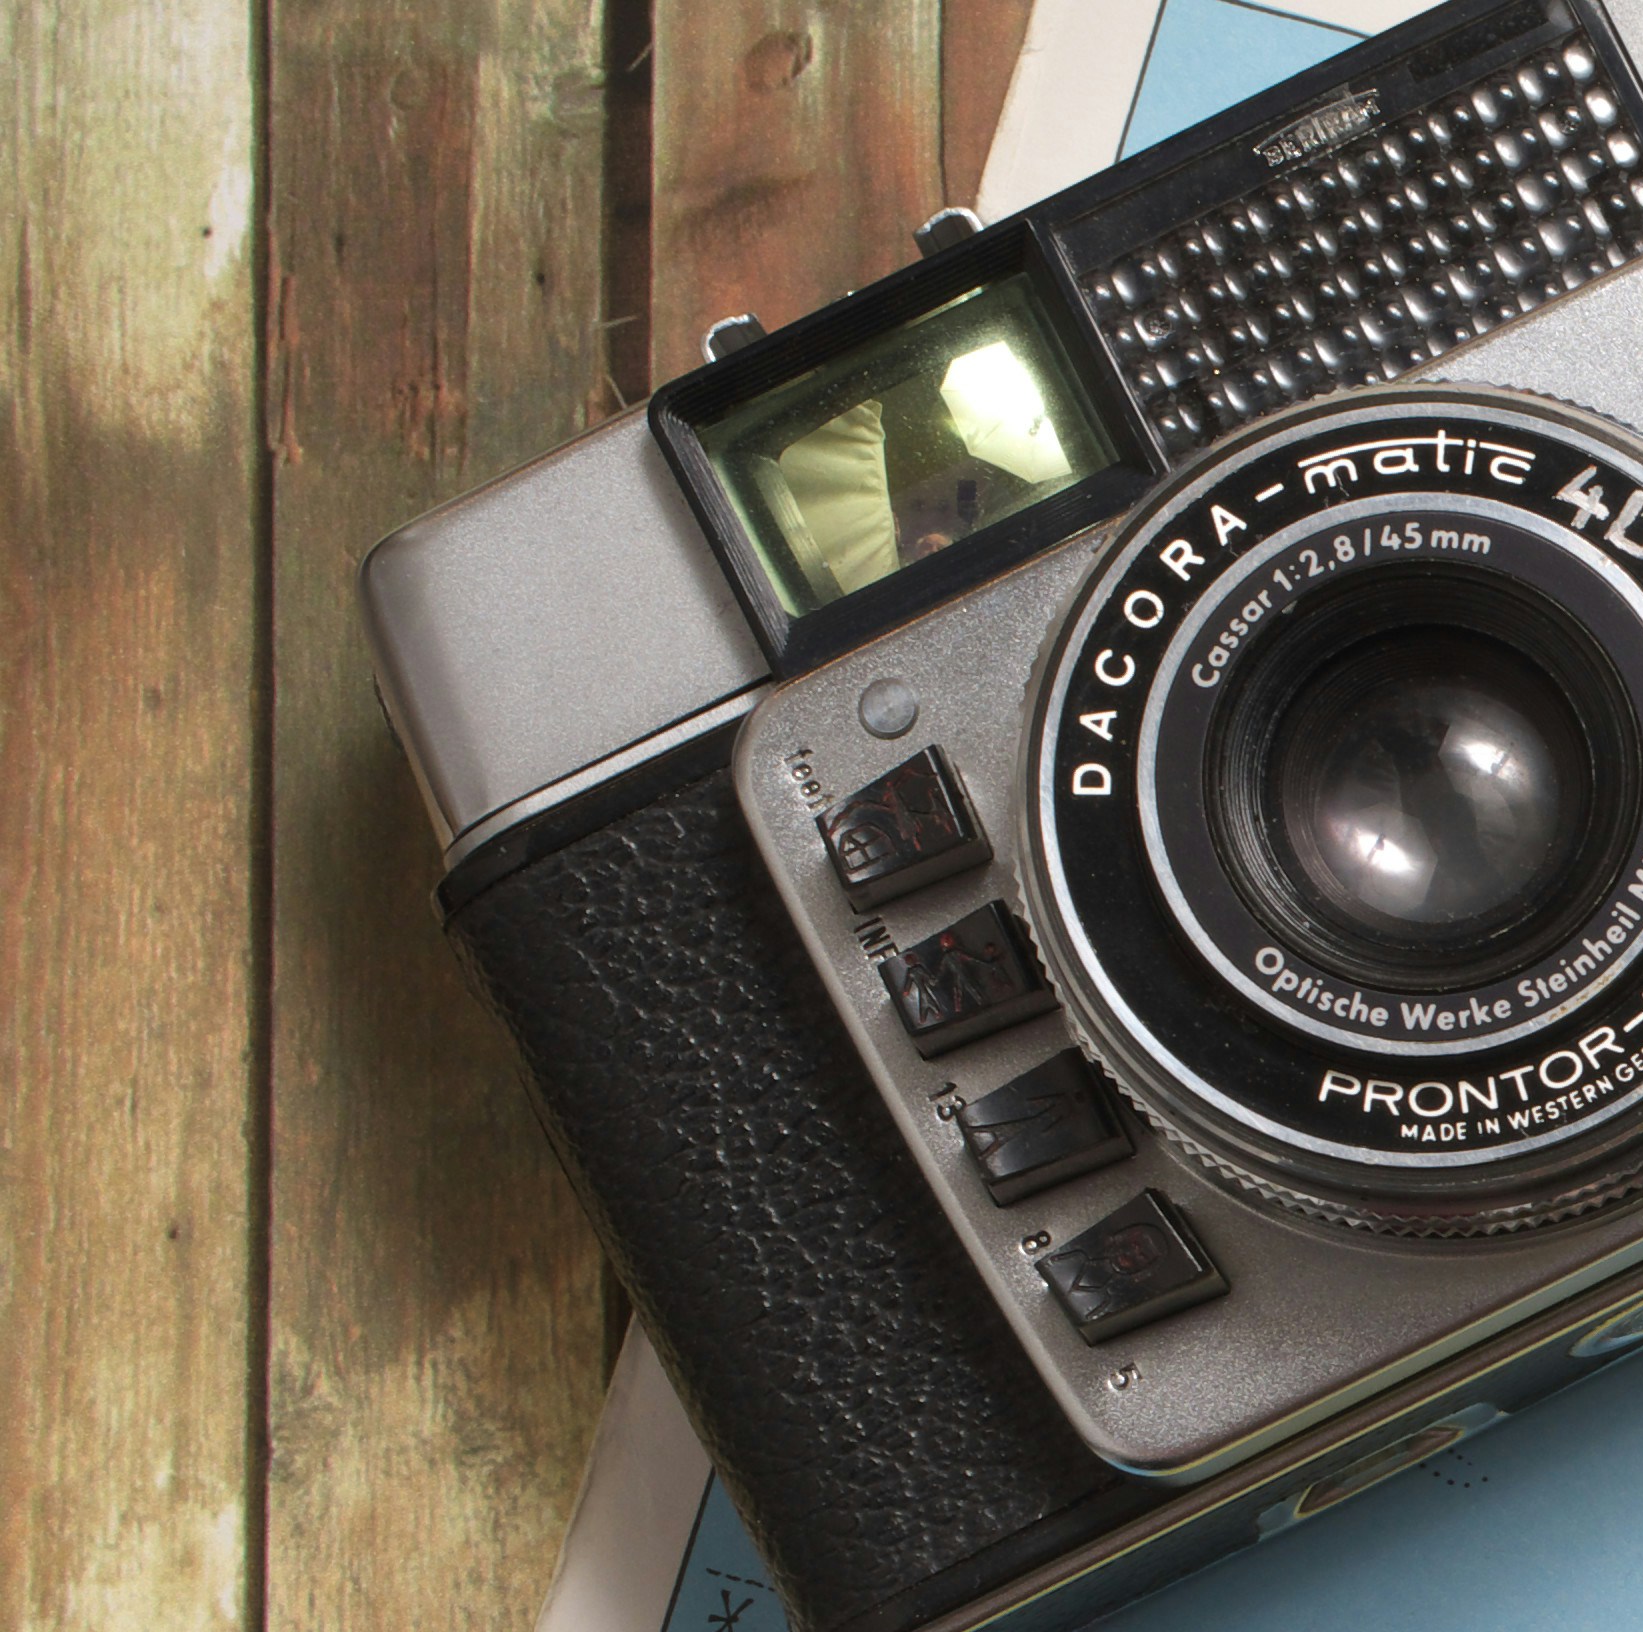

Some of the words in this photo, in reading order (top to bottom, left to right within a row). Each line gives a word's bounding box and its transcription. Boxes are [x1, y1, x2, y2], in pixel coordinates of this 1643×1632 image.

[1191, 588, 1273, 689] Cassar
[1255, 945, 1390, 1027] Optische
[1400, 997, 1512, 1032] Werke
[1519, 909, 1638, 1007] Steinheil
[1400, 1120, 1468, 1141] MADE
[1477, 1119, 1500, 1136] IN
[1508, 1078, 1614, 1129] WESTERN
[1020, 1229, 1052, 1256] 8
[1106, 1362, 1143, 1391] 5
